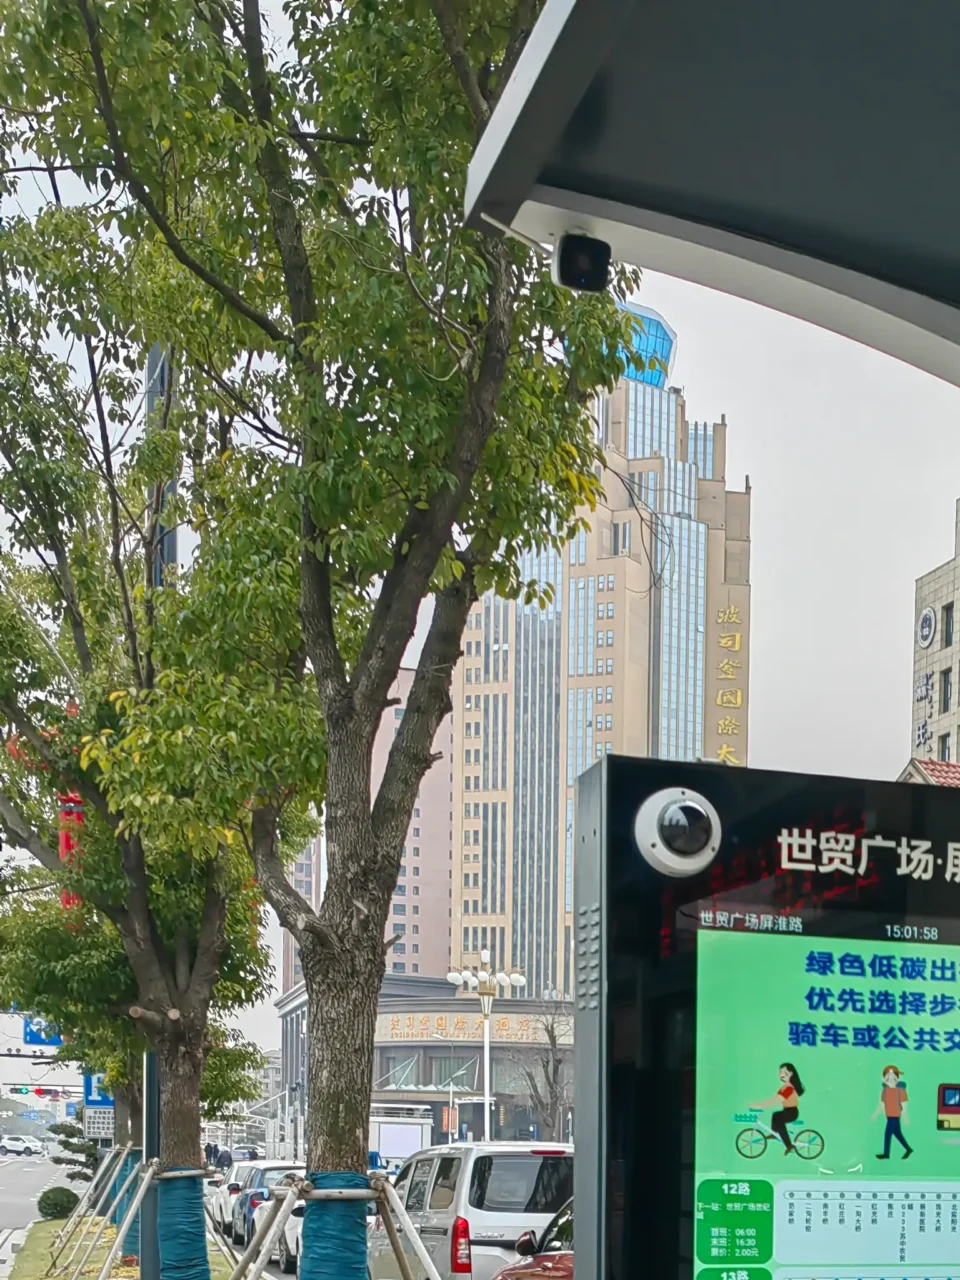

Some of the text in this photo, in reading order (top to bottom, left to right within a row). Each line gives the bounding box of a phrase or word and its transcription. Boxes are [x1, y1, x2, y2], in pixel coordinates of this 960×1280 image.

[700, 910, 803, 933] 世贸广场屏淮路
[885, 924, 938, 940] 15:01:58
[721, 1182, 750, 1195] 12路
